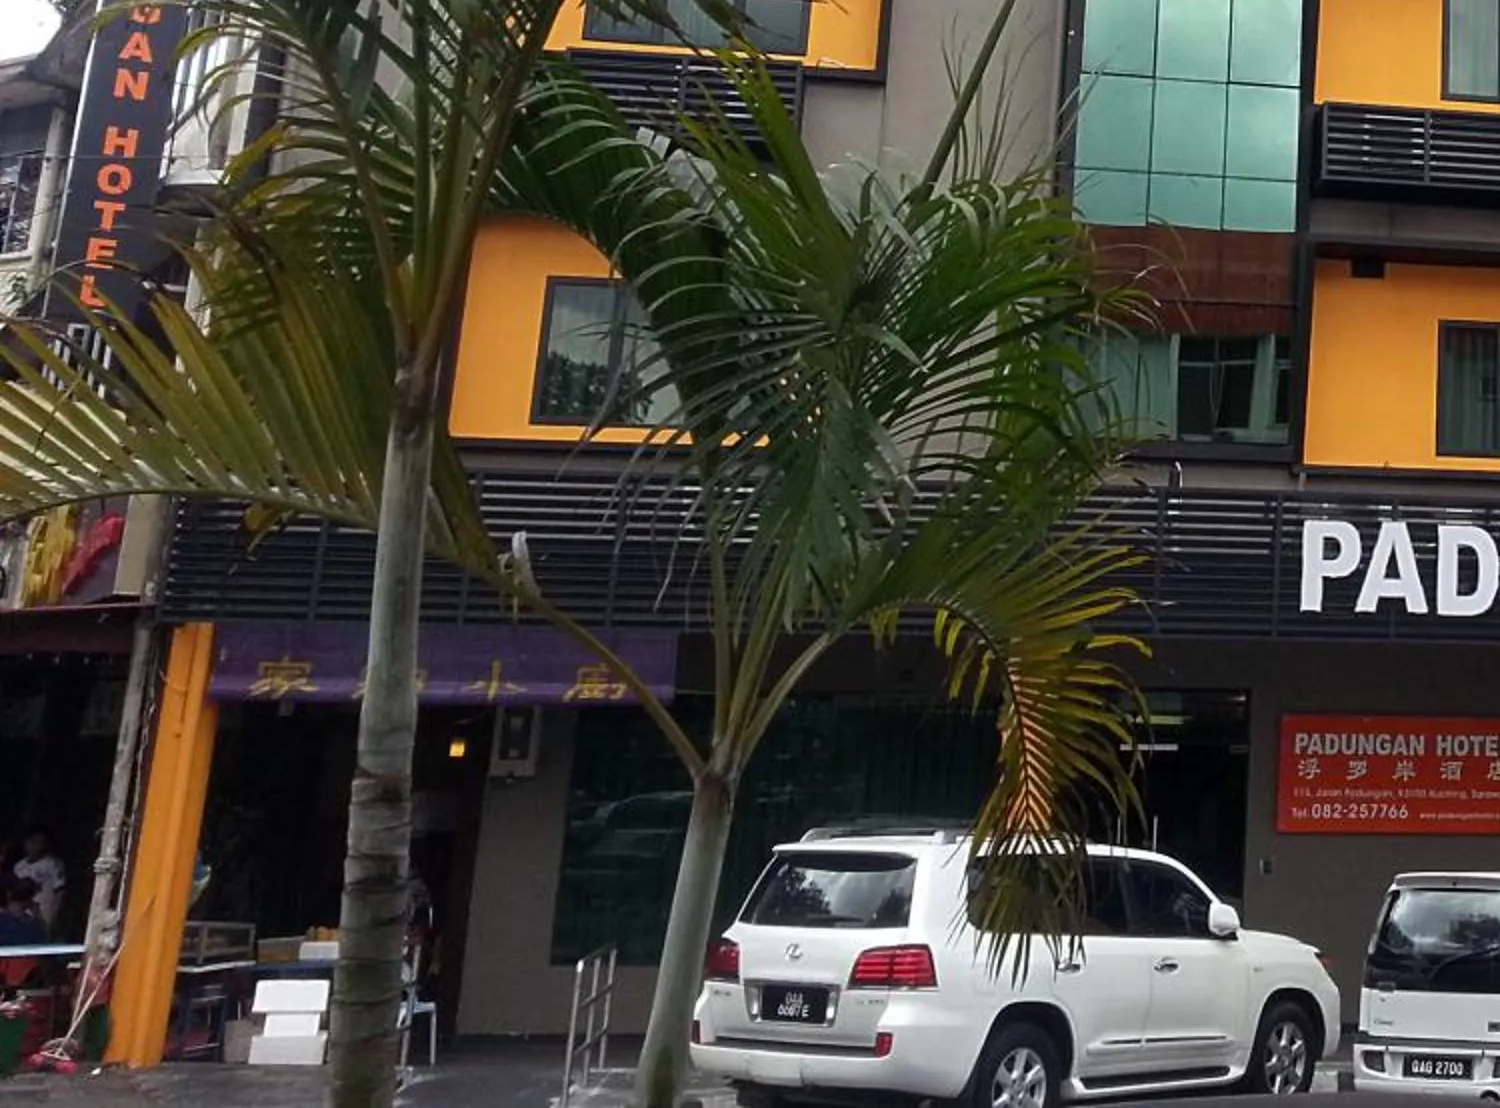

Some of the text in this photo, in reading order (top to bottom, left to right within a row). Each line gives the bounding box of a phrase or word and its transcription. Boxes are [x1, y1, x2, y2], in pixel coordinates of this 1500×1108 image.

[78, 125, 140, 309] HOTEL
[1294, 732, 1425, 756] PADUNGAN
[1311, 803, 1409, 820] 082-257766
